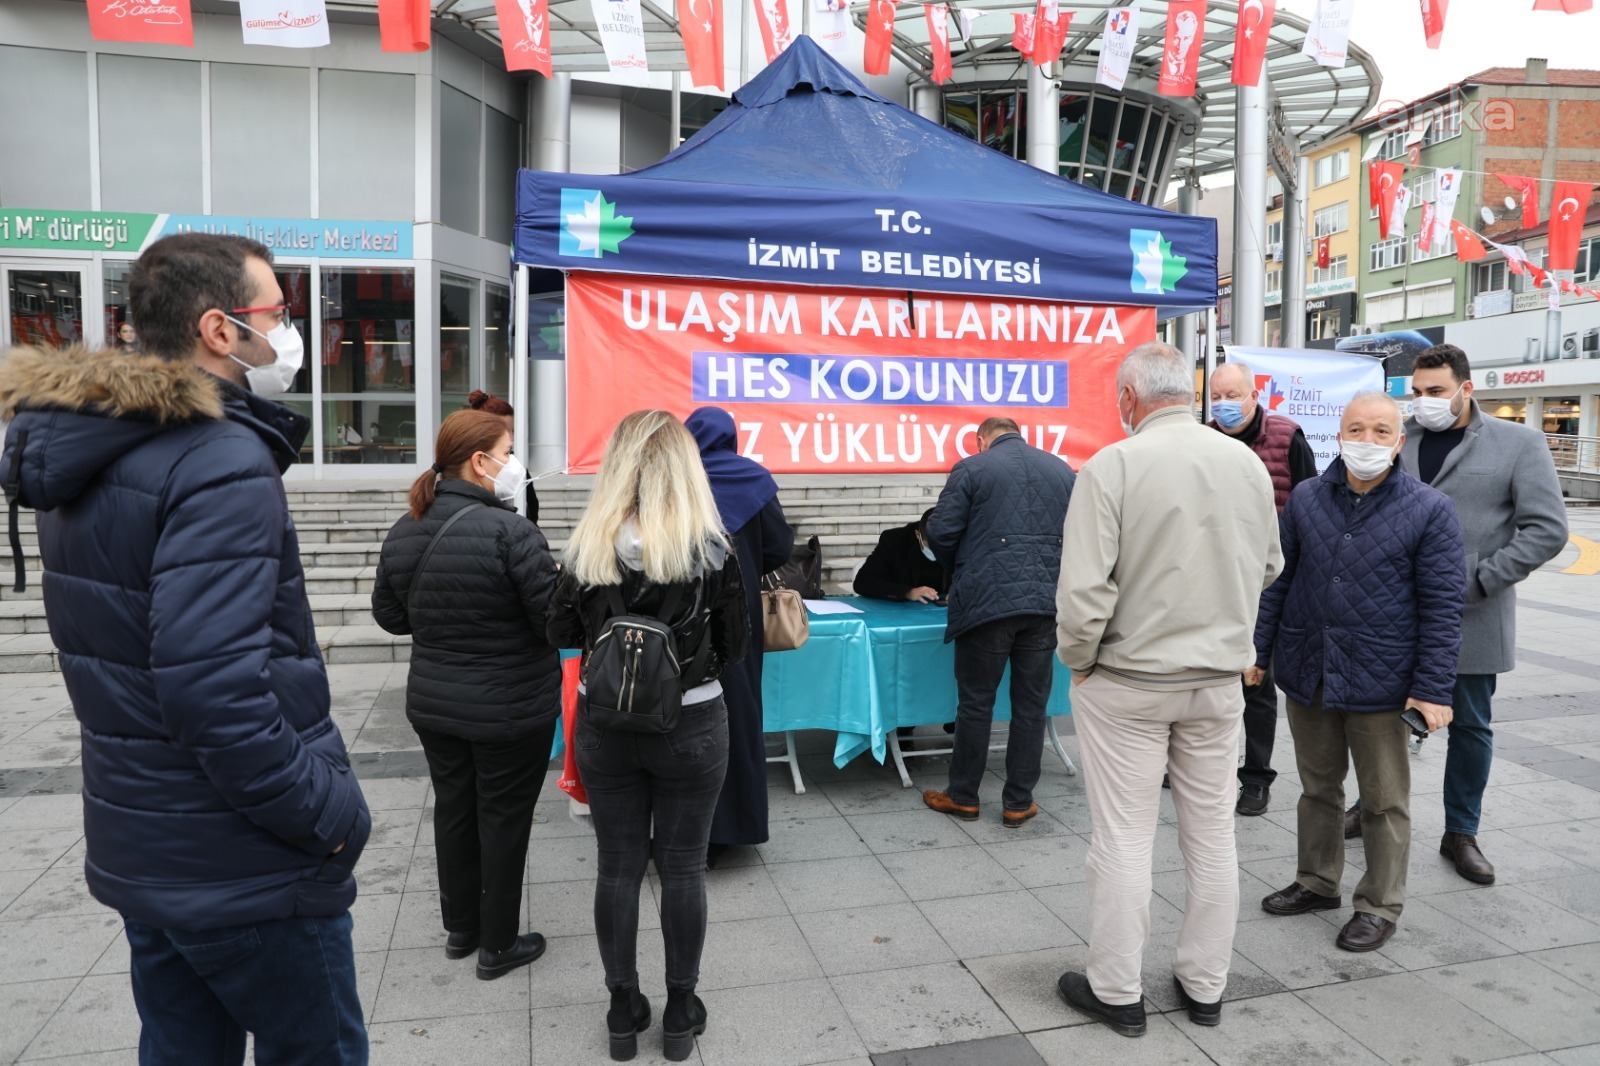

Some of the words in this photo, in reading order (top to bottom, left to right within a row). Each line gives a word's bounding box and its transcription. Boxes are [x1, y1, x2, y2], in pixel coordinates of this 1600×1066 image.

[246, 19, 281, 29] Gülümse
[611, 11, 635, 24] İZMİT
[875, 208, 932, 235] T.C.
[15, 216, 129, 249] Mdürlüğü
[324, 227, 399, 251] Merkezi
[748, 238, 840, 270] İZMİT
[861, 250, 1041, 285] BELEDİYESİ
[622, 288, 802, 343] ULAŞIM
[820, 296, 1125, 345] KARTLARINIZA
[707, 357, 791, 399] HES
[810, 359, 1055, 403] KODUNUZU
[1290, 375, 1304, 386] T.C.
[1503, 369, 1546, 385] BOSCH
[1289, 387, 1323, 402] İZMİT
[1288, 403, 1344, 417] BELEDİYE
